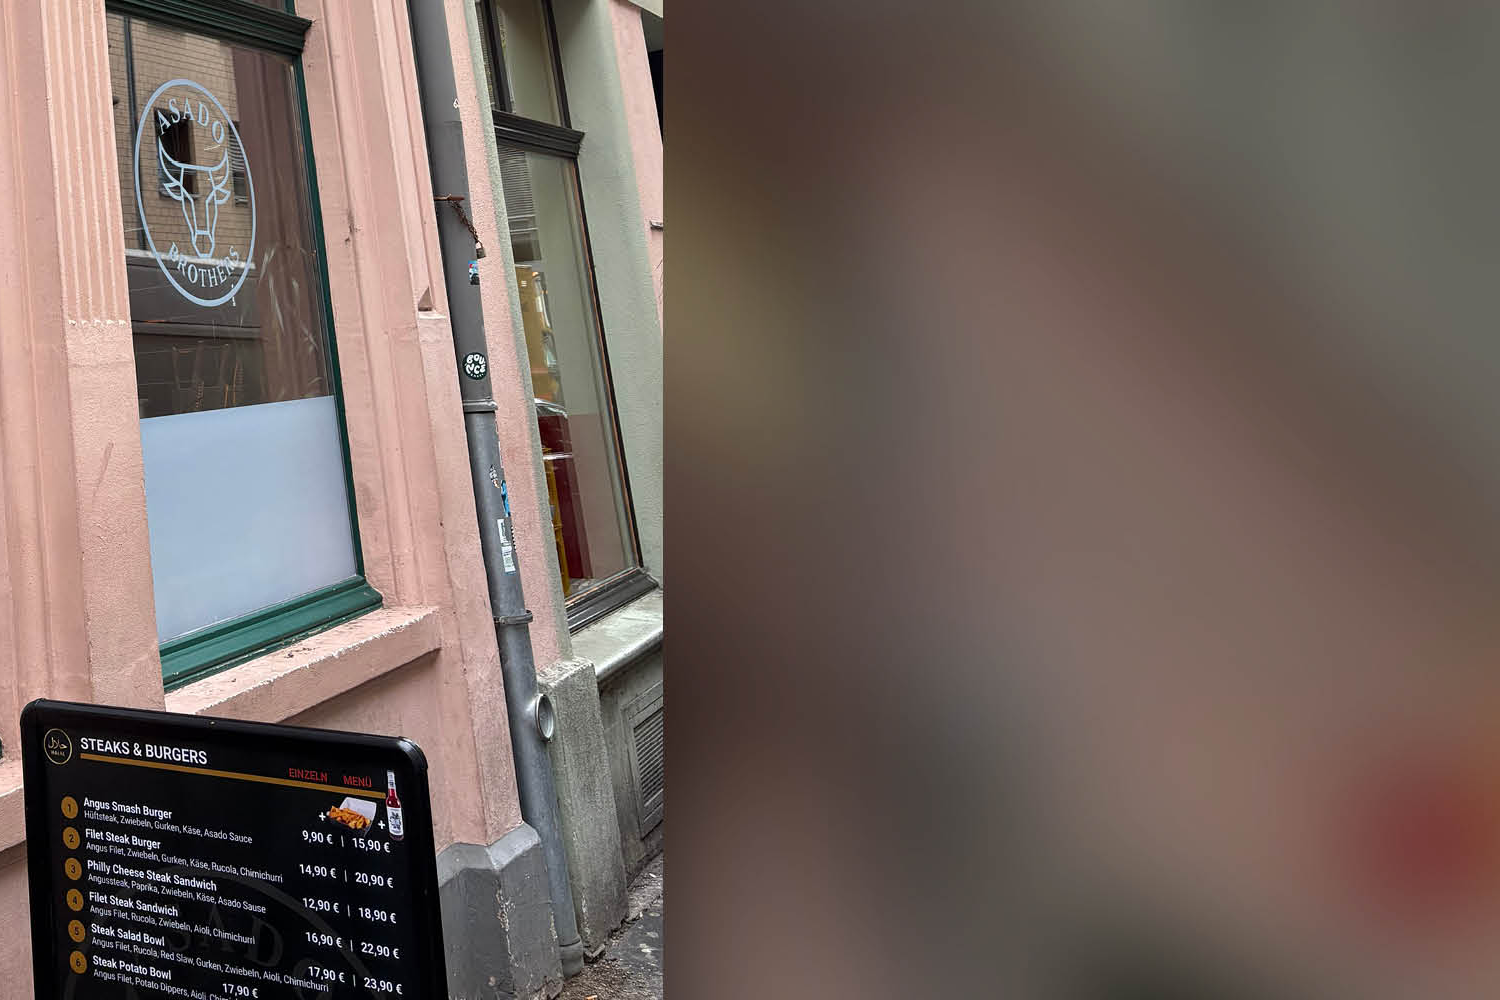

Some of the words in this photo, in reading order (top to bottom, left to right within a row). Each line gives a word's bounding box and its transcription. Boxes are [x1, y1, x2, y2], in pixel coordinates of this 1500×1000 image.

[157, 96, 225, 144] ASADO
[167, 242, 241, 288] BROTHERS
[80, 737, 129, 754] STEAKS
[134, 743, 142, 756] &
[146, 745, 207, 764] BURGERS
[289, 768, 327, 783] EINZELN
[343, 775, 372, 787] MENÜ
[67, 804, 72, 812] 1
[84, 798, 109, 810] Angus
[112, 802, 140, 814] Smash
[143, 806, 172, 820] Burger
[69, 834, 74, 842] 2
[86, 829, 103, 840] Filet
[106, 832, 130, 844] Steak
[132, 836, 161, 850] Burger
[84, 811, 119, 823] Hüftsteak,
[121, 816, 153, 829] Zwiebeln,
[155, 822, 181, 833] Gurken,
[183, 825, 202, 837] Käse,
[204, 829, 227, 839] Asado
[229, 832, 252, 843] Sauce
[303, 830, 324, 843] 9,90
[326, 833, 333, 845] €
[352, 838, 381, 851] 15,90
[383, 842, 391, 853] €
[71, 865, 76, 874] 3
[88, 860, 110, 874] Philly
[113, 864, 144, 878] Cheese
[147, 870, 171, 883] Steak
[174, 875, 217, 891] Sandwich
[86, 842, 107, 853] Angus
[109, 845, 125, 856] Filet,
[127, 848, 160, 862] Zwiebeln,
[162, 854, 188, 866] Gurken,
[190, 859, 210, 870] Käse,
[212, 862, 238, 875] Rucola,
[240, 867, 282, 883] Chimichurri
[300, 864, 327, 877] 14,90
[330, 868, 337, 879] €
[355, 872, 383, 886] 20,90
[387, 877, 394, 889] €
[73, 896, 77, 904] 4
[89, 892, 107, 903] Filet
[110, 896, 134, 908] Steak
[136, 900, 178, 916] Sandwich
[88, 874, 130, 888] Angussteak,
[132, 881, 159, 894] Paprika,
[161, 886, 194, 900] Zwiebeln,
[196, 892, 216, 904] Käse,
[218, 897, 241, 908] Asado
[90, 905, 111, 916] Angus
[114, 909, 129, 920] Filet,
[131, 912, 157, 925] Rucola,
[159, 918, 192, 932] Zwiebeln,
[194, 925, 211, 936] Aioli,
[213, 928, 255, 944] Chimichurri
[303, 898, 330, 911] 12,90
[333, 902, 340, 913] €
[359, 908, 386, 921] 18,90
[389, 912, 397, 924] €
[74, 927, 79, 936] 5
[92, 924, 115, 937] Steak
[118, 929, 141, 941] Salad
[144, 934, 165, 946] Bowl
[306, 932, 333, 946] 16,90
[336, 937, 343, 948] €
[361, 942, 389, 956] 22,90
[393, 948, 400, 959] €
[76, 959, 81, 967] 6
[93, 955, 117, 968] Steak
[120, 961, 147, 975] Potato
[150, 967, 171, 980] Bowl
[92, 937, 113, 948] Angus
[116, 941, 132, 952] Filet,
[134, 945, 159, 958] Rucola,
[161, 950, 174, 960] Red
[176, 953, 194, 966] Slaw,
[196, 958, 223, 972] Gurken,
[225, 964, 261, 979] Zwiebeln,
[263, 971, 282, 983] Aioli,
[284, 975, 328, 992] Chimichurri
[94, 969, 115, 980] Angus
[117, 974, 134, 985] Filet,
[135, 977, 159, 989] Potato
[160, 982, 189, 997] Dippers,
[223, 984, 249, 996] 17,90
[252, 988, 259, 999] €
[308, 966, 335, 980] 17,90
[338, 972, 346, 983] €
[364, 977, 393, 992] 23,90
[396, 983, 403, 995] €
